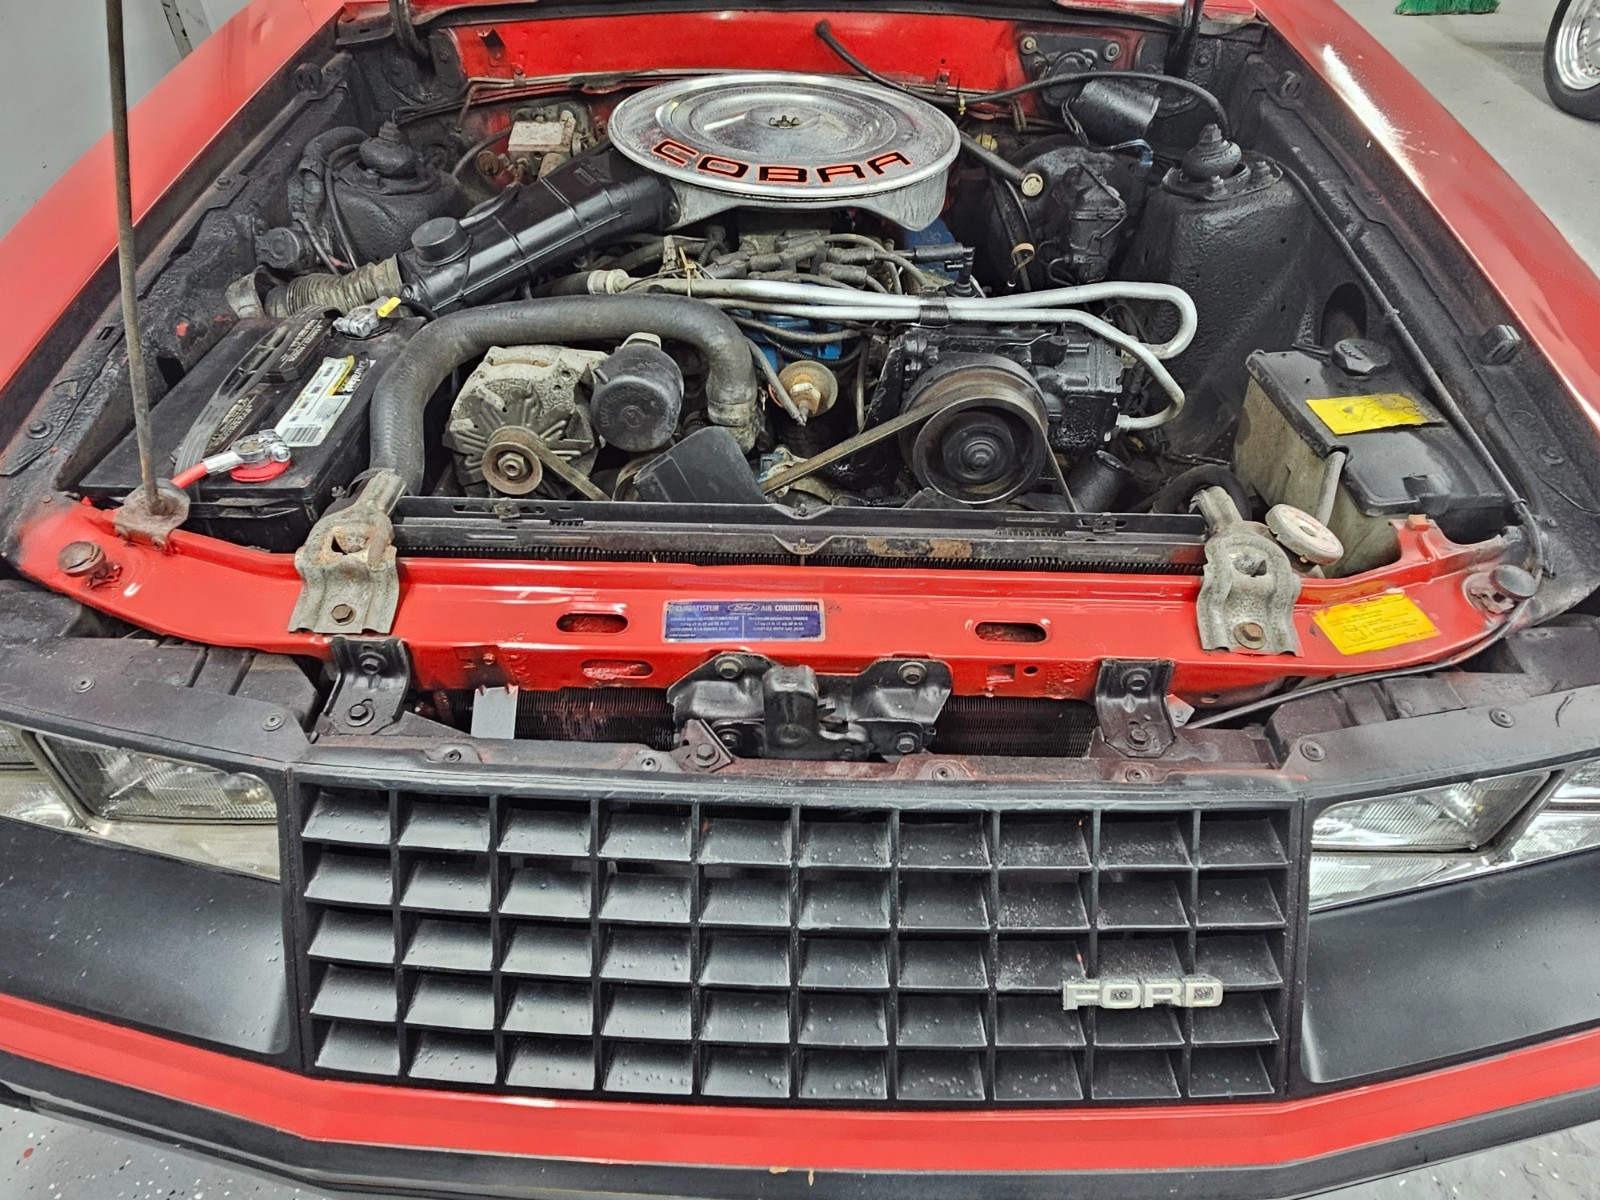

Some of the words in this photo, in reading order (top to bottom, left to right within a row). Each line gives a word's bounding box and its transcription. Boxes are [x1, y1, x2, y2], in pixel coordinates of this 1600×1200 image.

[652, 138, 912, 184] COBRA
[760, 604, 773, 612] AIR
[774, 604, 819, 612] CONDITIONER
[1063, 977, 1223, 1010] FORD
